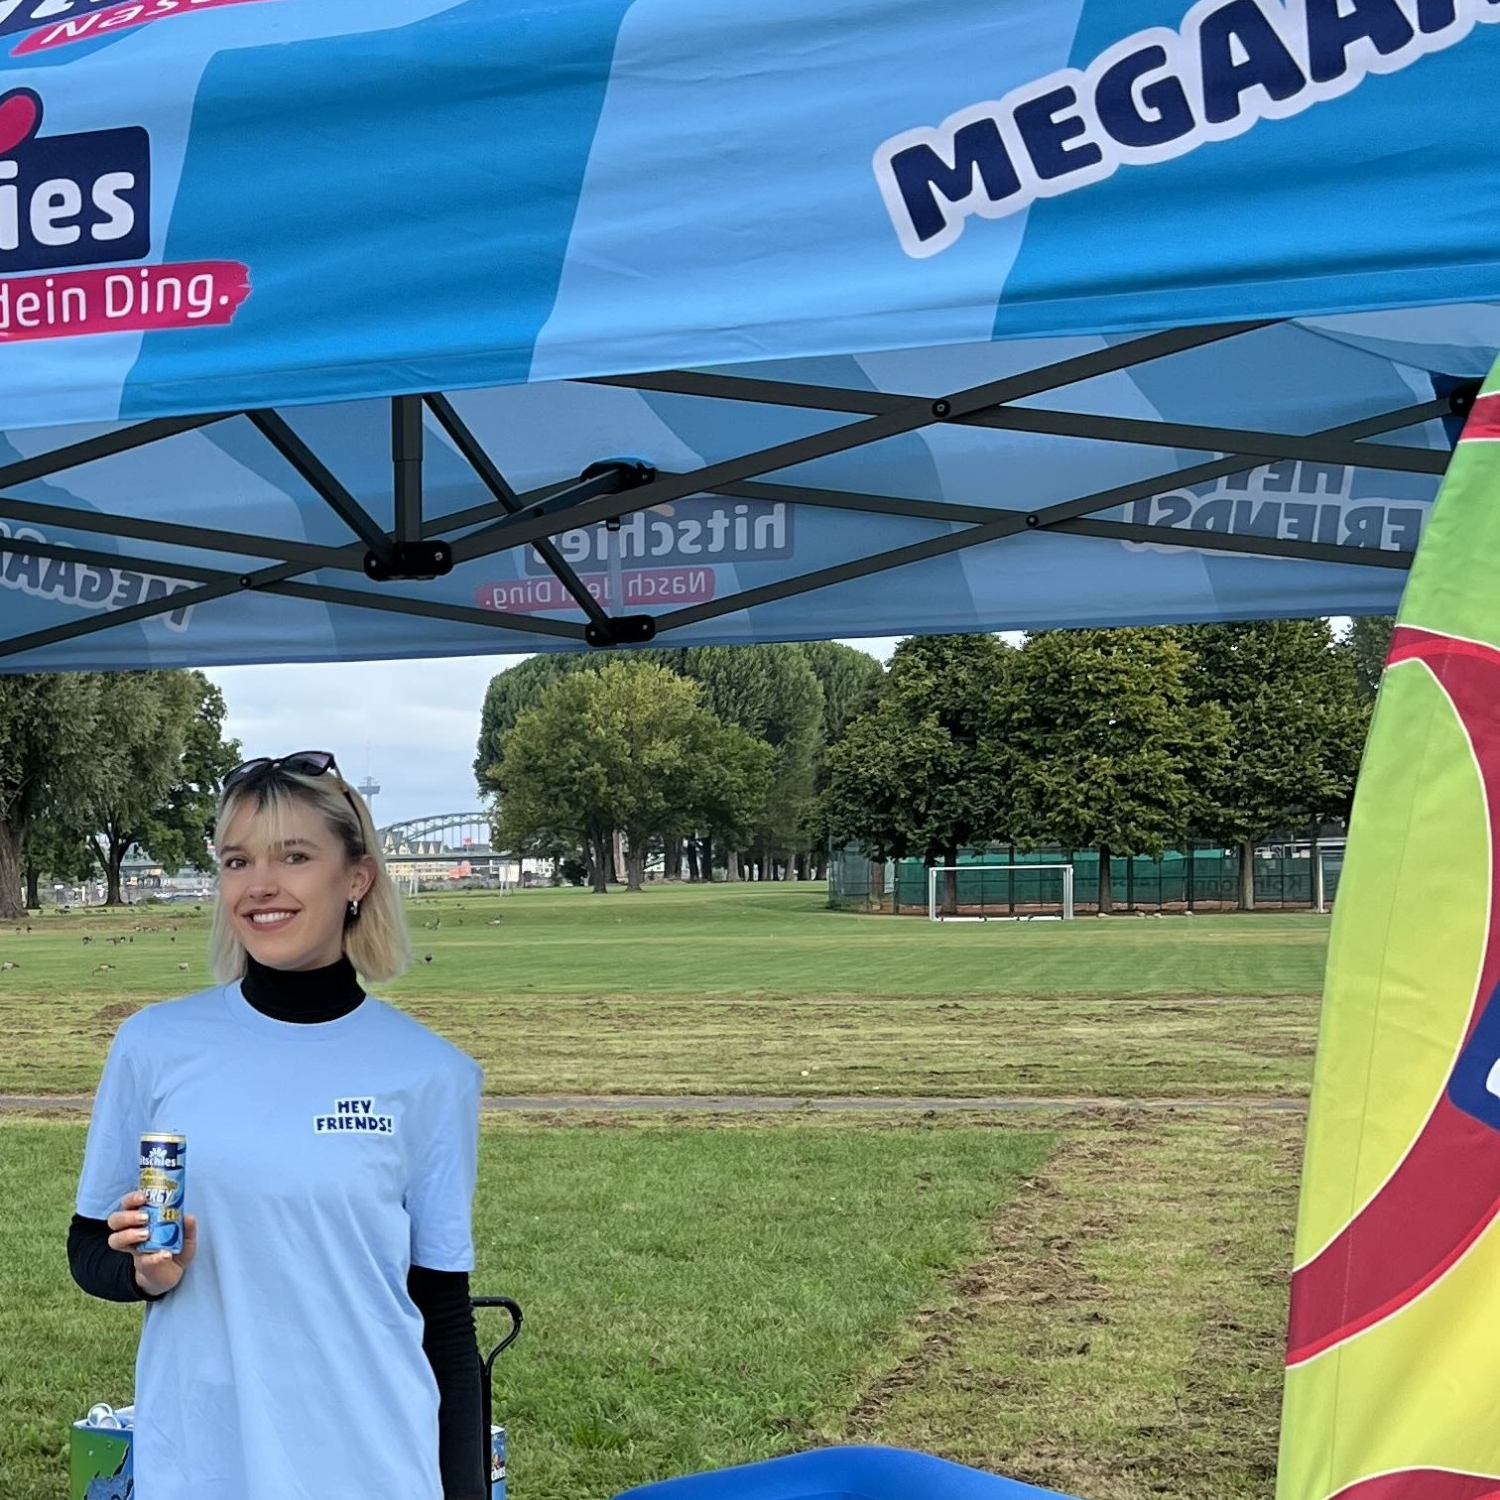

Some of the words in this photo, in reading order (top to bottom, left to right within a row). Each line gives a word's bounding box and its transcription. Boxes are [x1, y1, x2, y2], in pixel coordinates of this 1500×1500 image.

[890, 0, 1500, 241] MEGAA
[105, 268, 229, 320] Ding.
[338, 1099, 371, 1114] HEY
[316, 1116, 393, 1133] FRIENDS!
